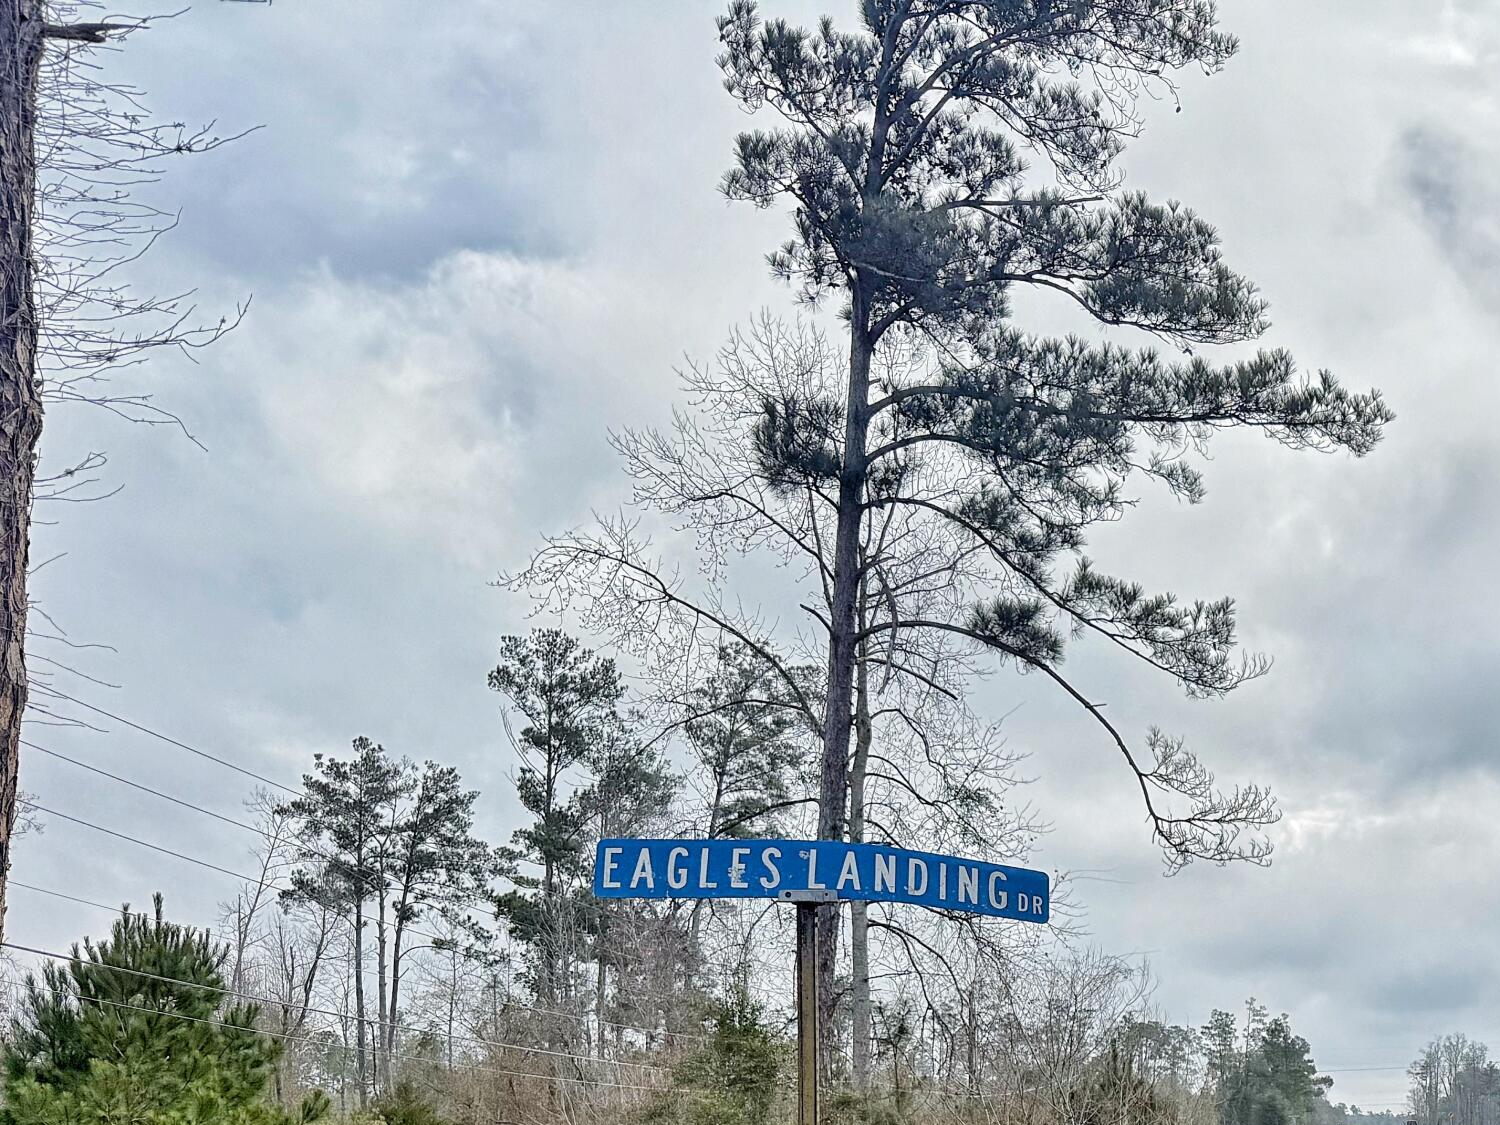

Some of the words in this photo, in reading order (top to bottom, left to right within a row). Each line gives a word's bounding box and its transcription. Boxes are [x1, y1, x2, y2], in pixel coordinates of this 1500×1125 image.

[602, 847, 781, 889] EAGLES
[807, 850, 1009, 909] LANDING
[1018, 892, 1044, 915] DR
